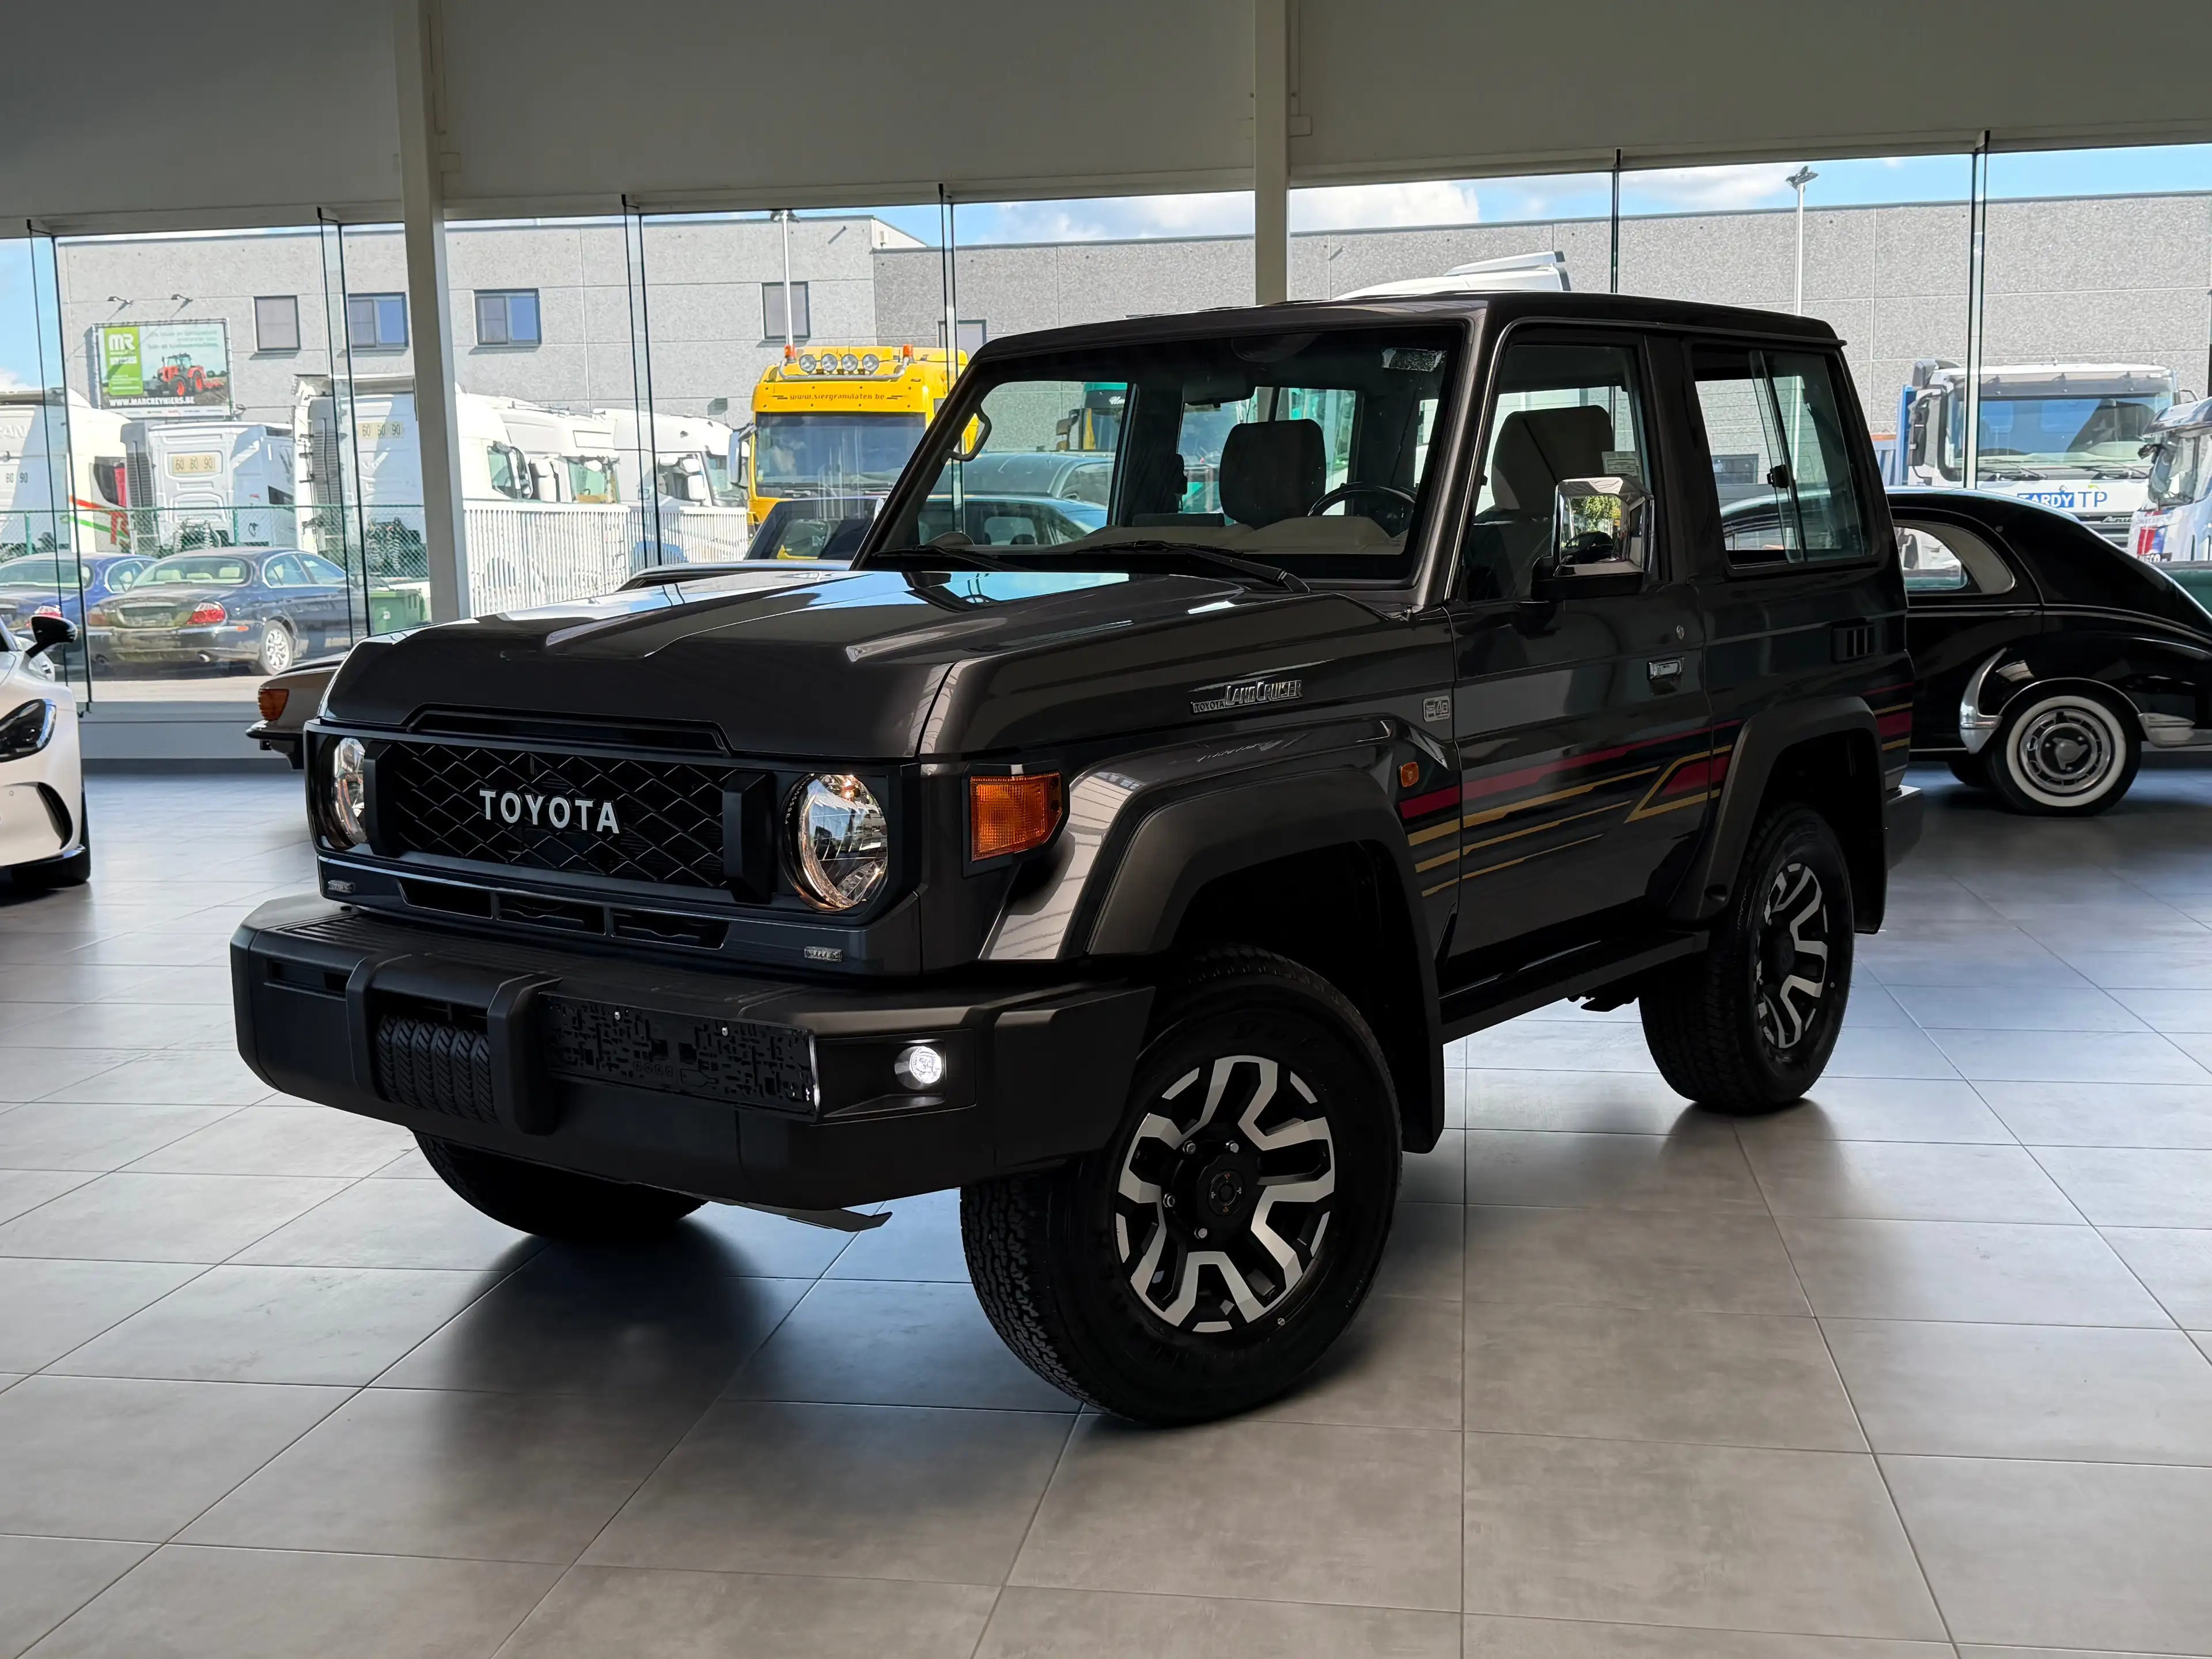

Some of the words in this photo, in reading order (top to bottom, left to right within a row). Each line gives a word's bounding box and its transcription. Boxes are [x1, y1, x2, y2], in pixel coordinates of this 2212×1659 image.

[392, 424, 400, 435] 90
[204, 457, 213, 469] 90
[20, 472, 28, 483] 90
[2078, 491, 2107, 507] TP
[1194, 701, 1225, 712] TOYOTA
[479, 789, 620, 834] TOYOTA
